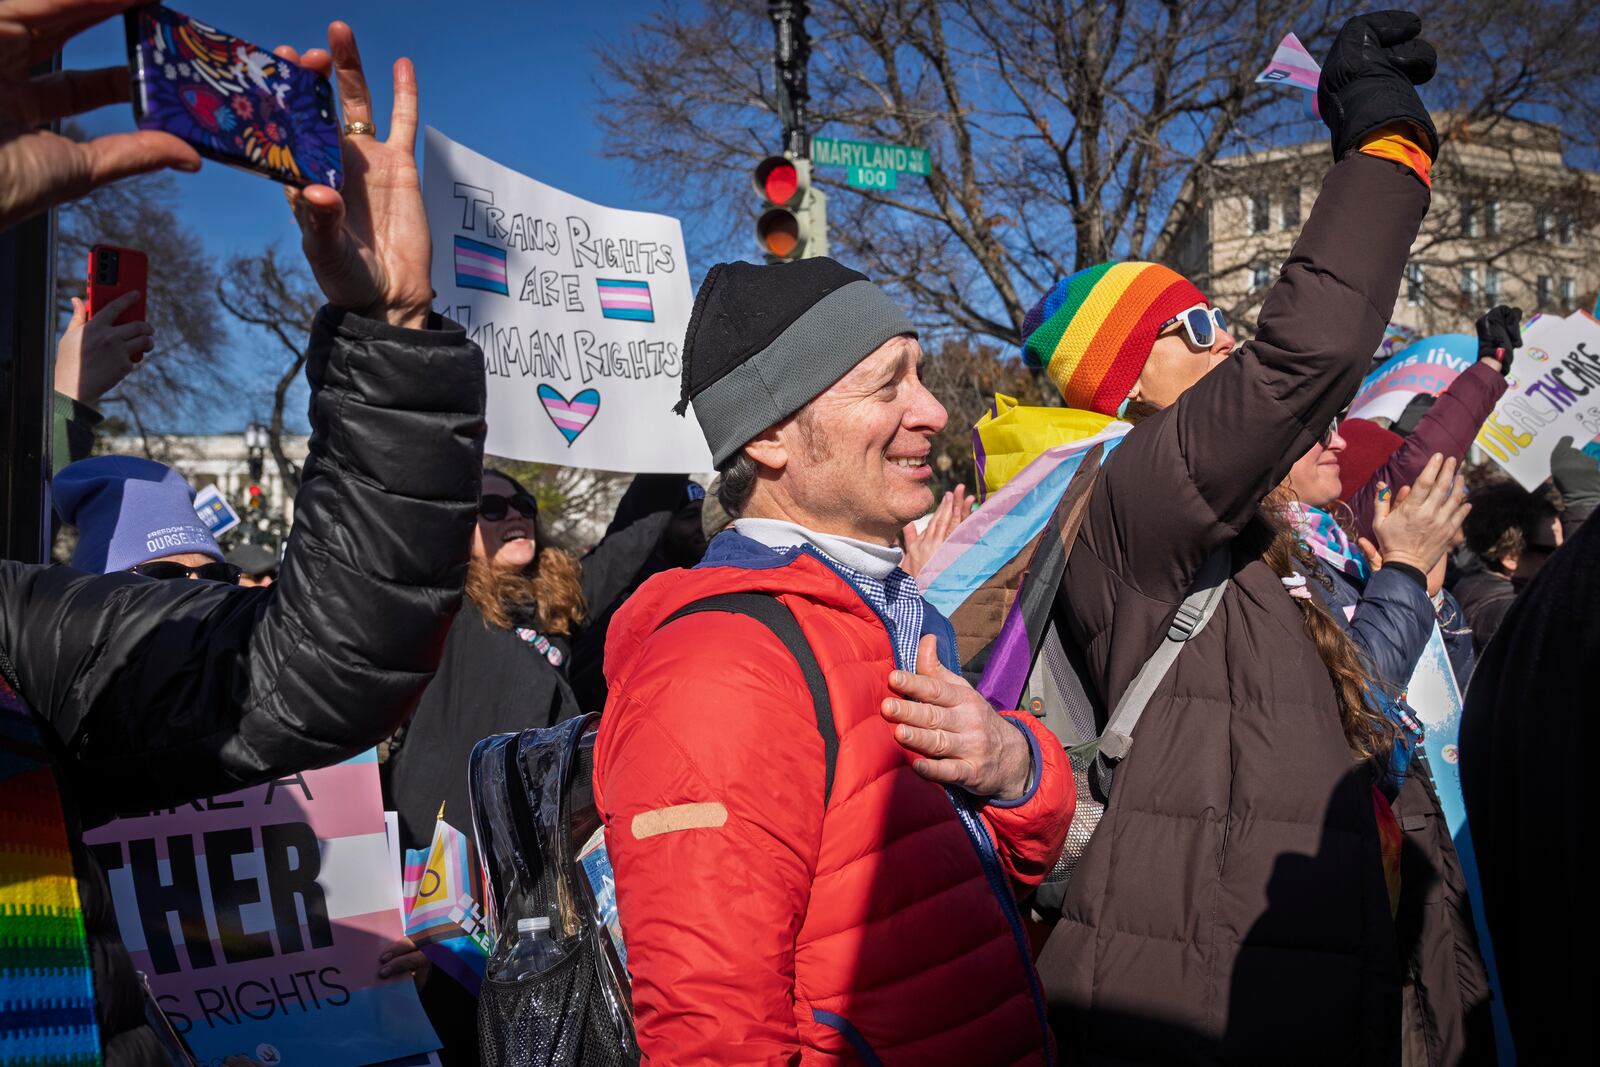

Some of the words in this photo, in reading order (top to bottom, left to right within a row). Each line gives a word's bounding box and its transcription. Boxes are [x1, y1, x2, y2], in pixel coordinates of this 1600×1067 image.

[816, 140, 907, 171] MARYLAND
[858, 169, 887, 187] 100
[454, 182, 560, 256] TRANS
[567, 216, 675, 275] RIGHTS
[520, 266, 584, 312] ARE
[575, 330, 681, 384] RIGHTS
[196, 966, 351, 1029] RIGHTS
